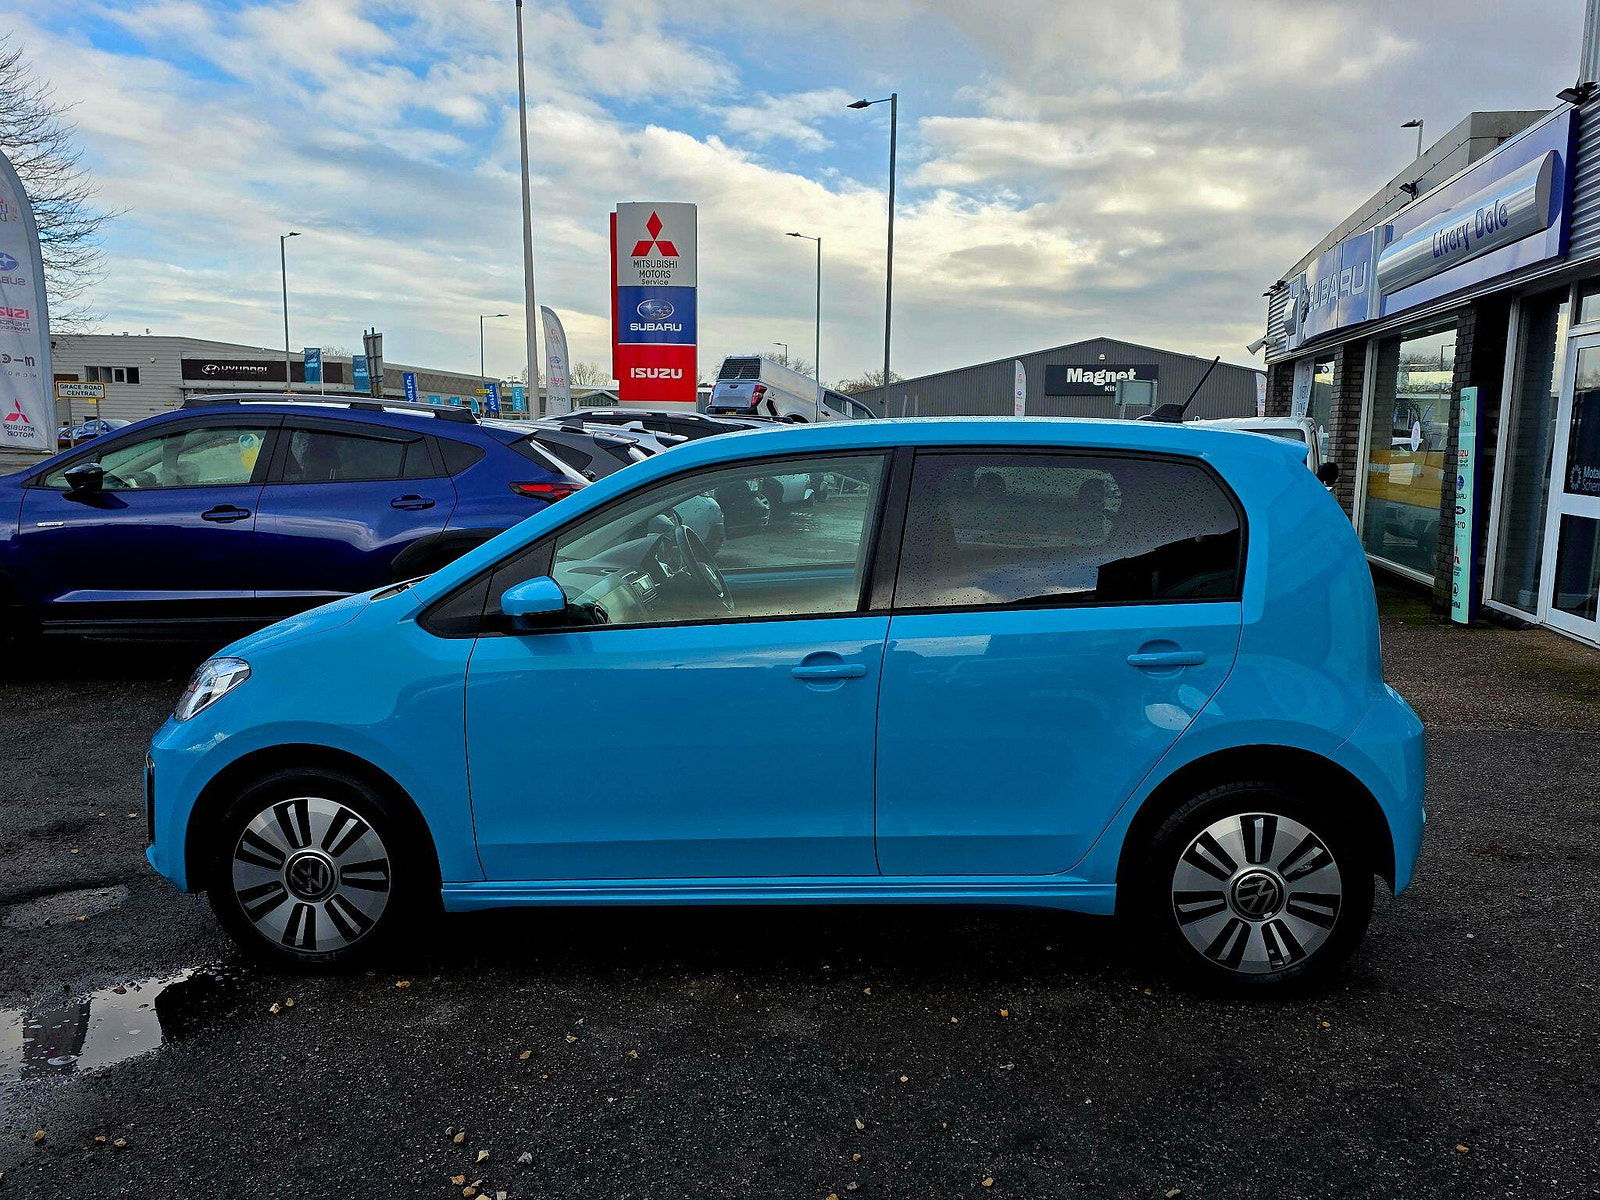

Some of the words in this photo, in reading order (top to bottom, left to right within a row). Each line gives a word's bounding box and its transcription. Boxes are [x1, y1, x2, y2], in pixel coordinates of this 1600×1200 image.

[1432, 223, 1470, 259] Livery
[633, 260, 678, 269] MITSUBISHI
[639, 270, 671, 278] MOTORS
[1308, 261, 1368, 311] SUBARU
[630, 323, 682, 331] SUBARU
[630, 368, 682, 379] ISUZU
[1066, 367, 1137, 386] Magnet
[1583, 465, 1600, 479] Mota
